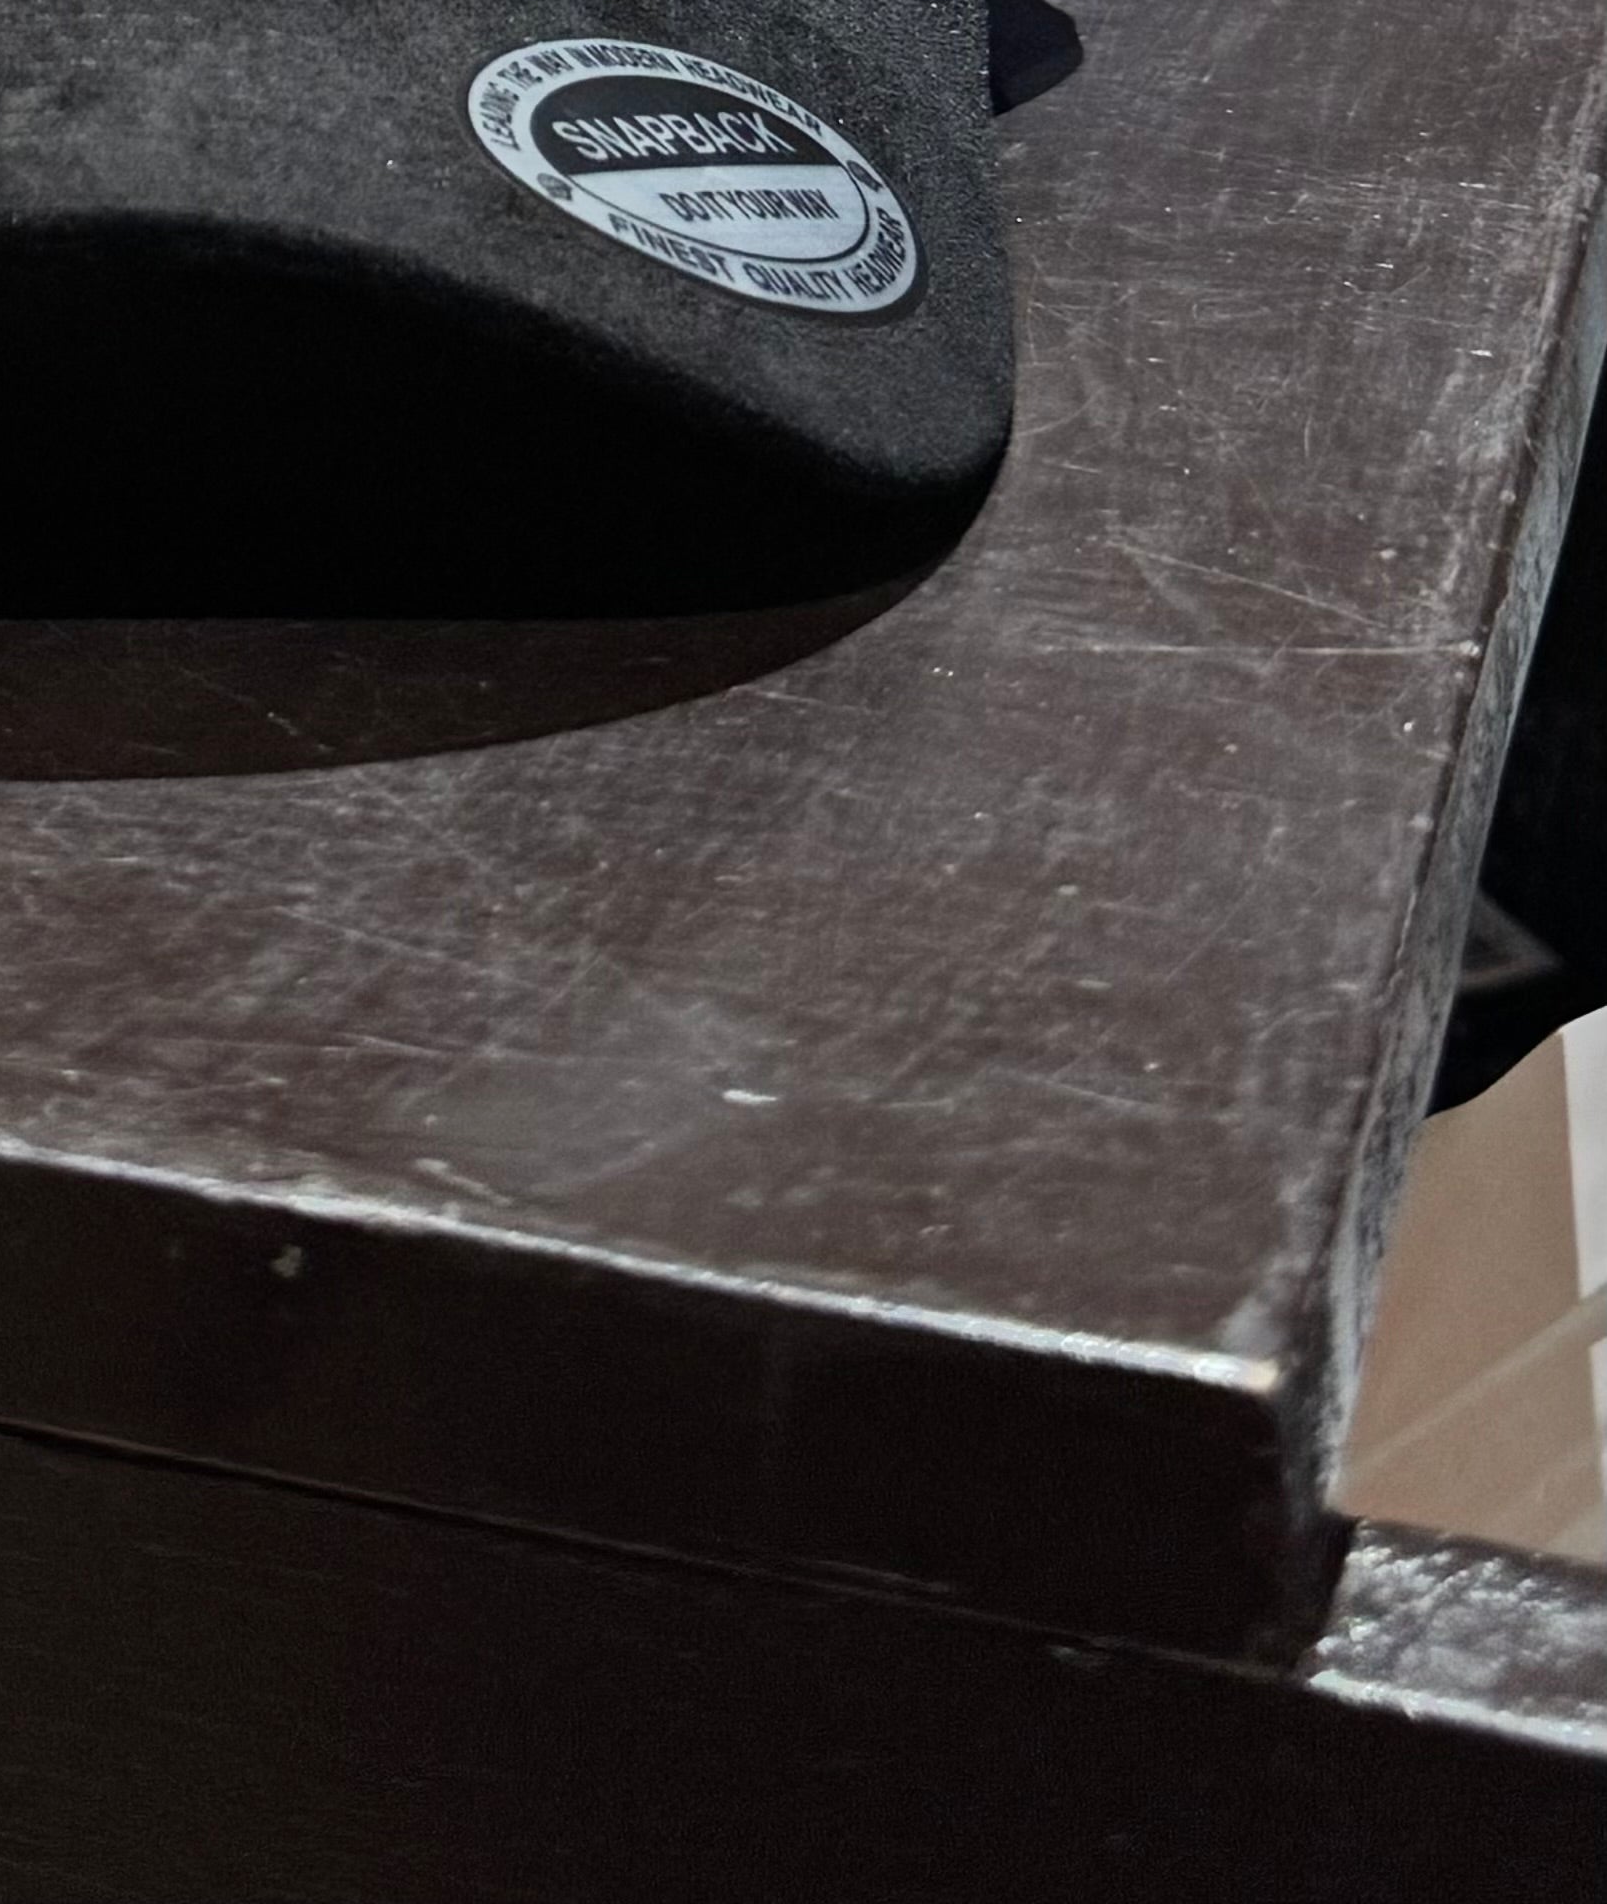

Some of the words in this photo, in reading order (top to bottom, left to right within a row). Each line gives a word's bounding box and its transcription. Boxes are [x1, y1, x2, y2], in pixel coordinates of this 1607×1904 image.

[497, 60, 543, 90] THE
[524, 48, 575, 77] WAY
[583, 43, 682, 74] MODERN
[479, 81, 521, 152] LEADING
[677, 55, 824, 138] HEADWEAR
[551, 111, 797, 161] SNAPBACK
[658, 190, 712, 222] DO
[714, 189, 799, 221] YOUR
[778, 188, 841, 221] WAY
[607, 212, 736, 283] FINEST
[742, 261, 854, 301] QUALITY
[843, 206, 907, 298] HEADWEAR
